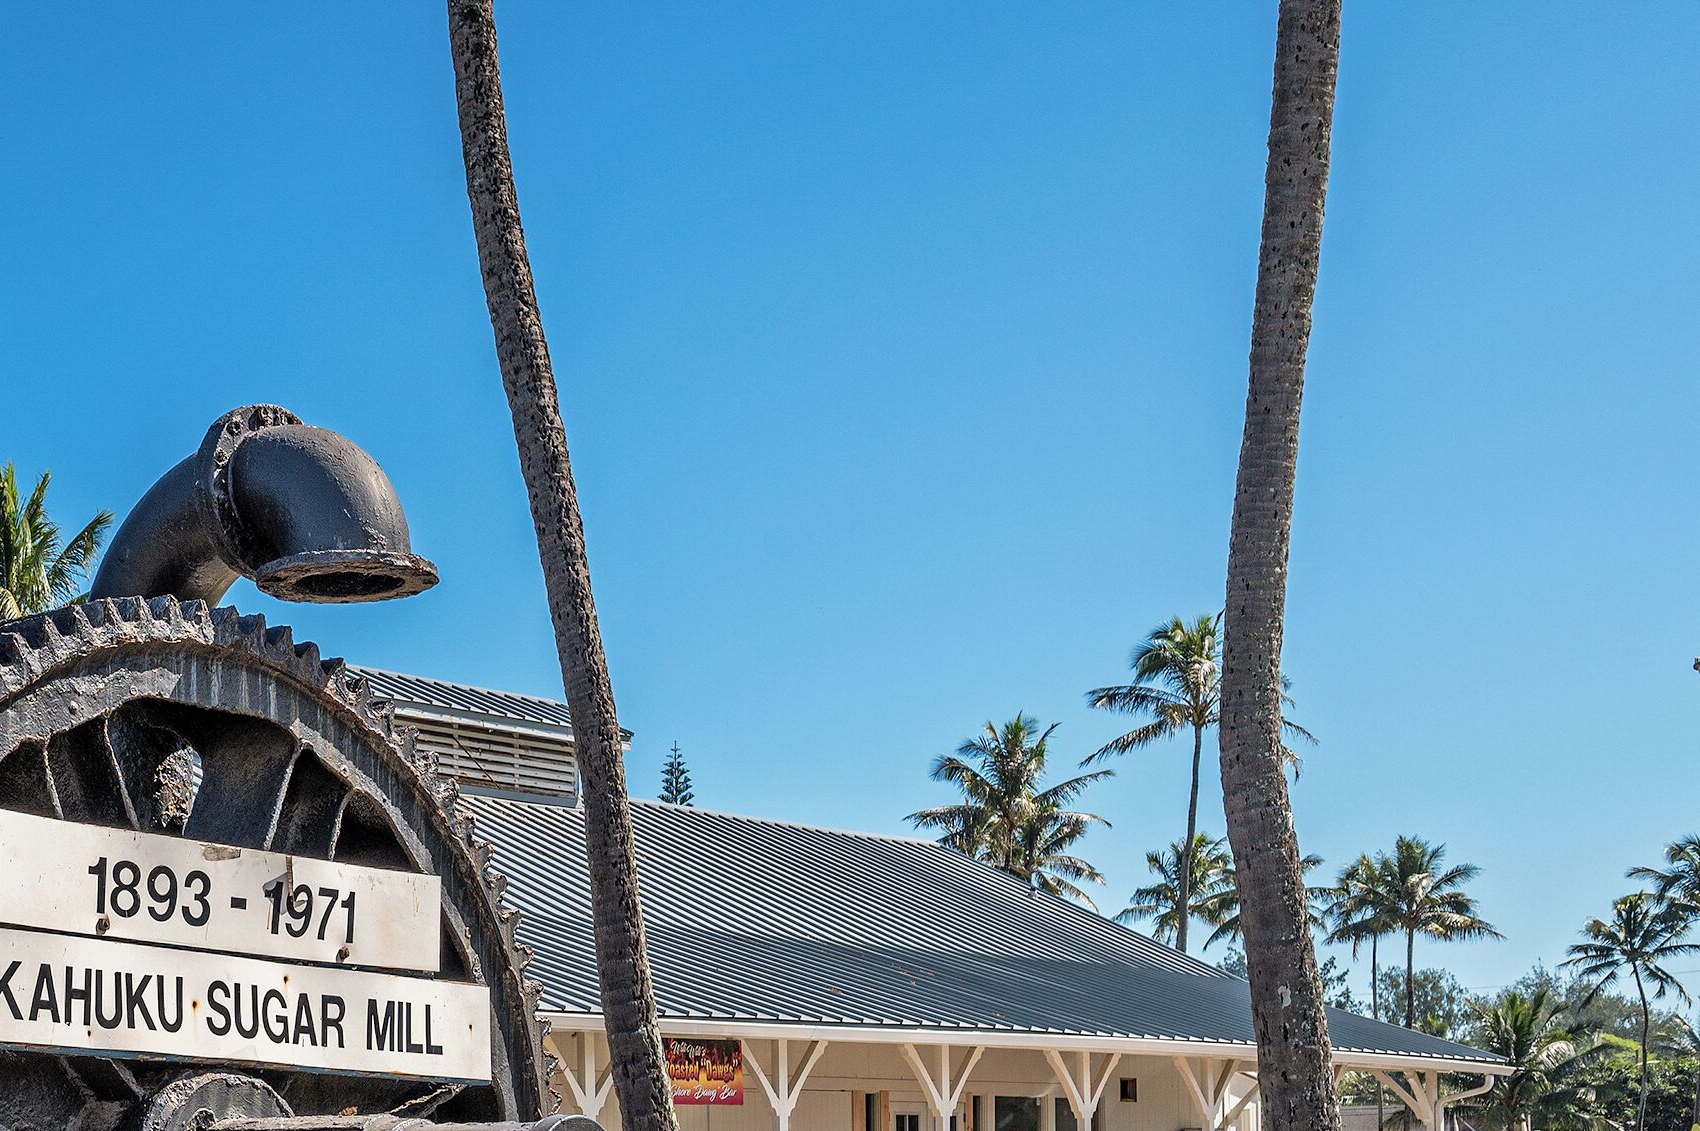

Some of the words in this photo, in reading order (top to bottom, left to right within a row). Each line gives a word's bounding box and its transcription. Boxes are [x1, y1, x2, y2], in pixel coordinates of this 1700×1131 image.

[87, 856, 211, 928] 1893
[230, 896, 248, 909] -
[264, 880, 357, 945] 1971
[205, 979, 346, 1050] SUGAR
[365, 998, 443, 1056] MILL
